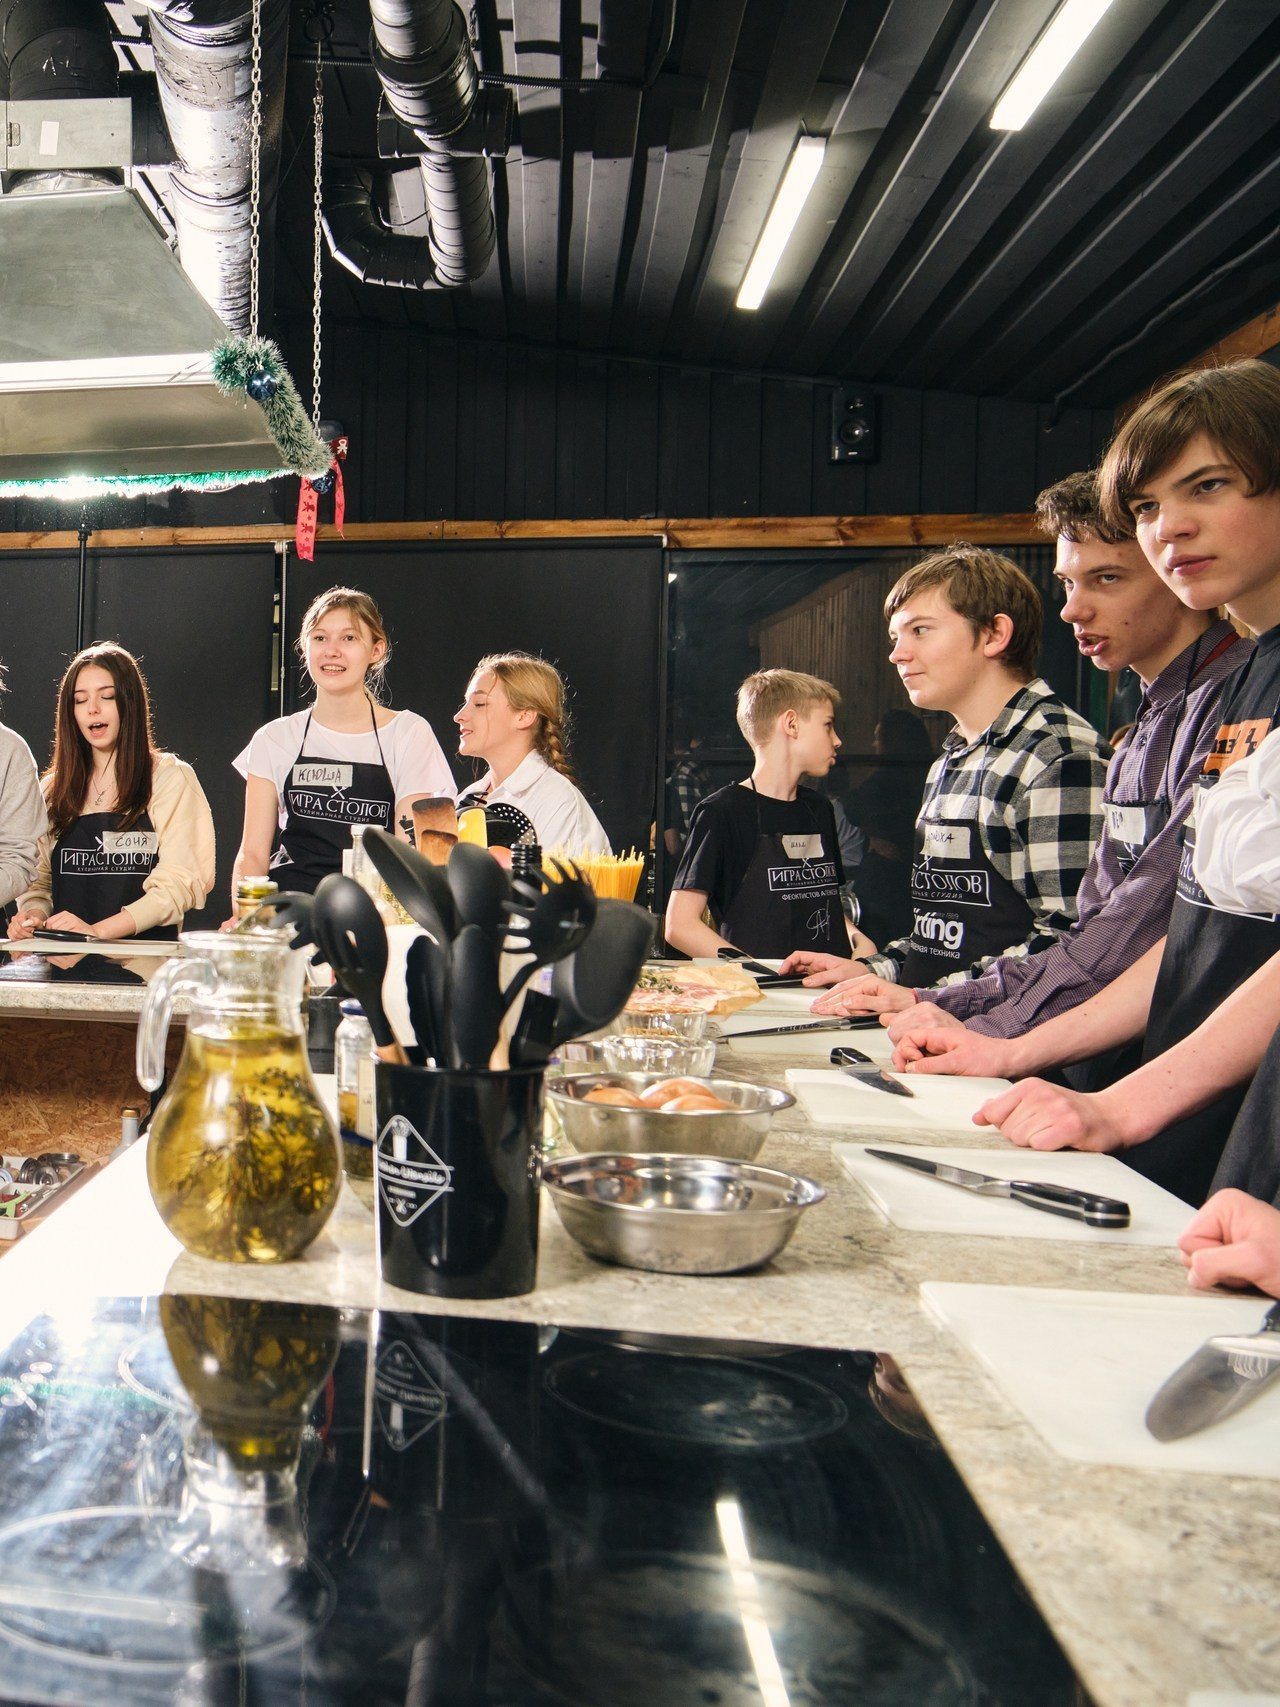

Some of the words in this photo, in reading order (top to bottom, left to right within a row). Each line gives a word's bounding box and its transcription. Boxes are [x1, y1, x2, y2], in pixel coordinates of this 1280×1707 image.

[299, 767, 341, 783] КСЮША
[289, 793, 323, 811] ИГРА
[326, 798, 387, 818] СТОЛОВ
[300, 808, 342, 819] КУЛИНАРНАЯ
[345, 815, 370, 823] СТУДИЯ
[115, 837, 148, 848] СОНЯ
[64, 851, 97, 866] ИГРА
[95, 851, 150, 866] СТОЛОВ
[772, 870, 801, 882] ИГРА
[914, 870, 982, 894] СТОЛОВ
[782, 891, 820, 901] ФЕОКТИСТОВ
[931, 891, 963, 899] СТУДИЯ
[911, 907, 964, 950] rting
[929, 947, 961, 959] техника
